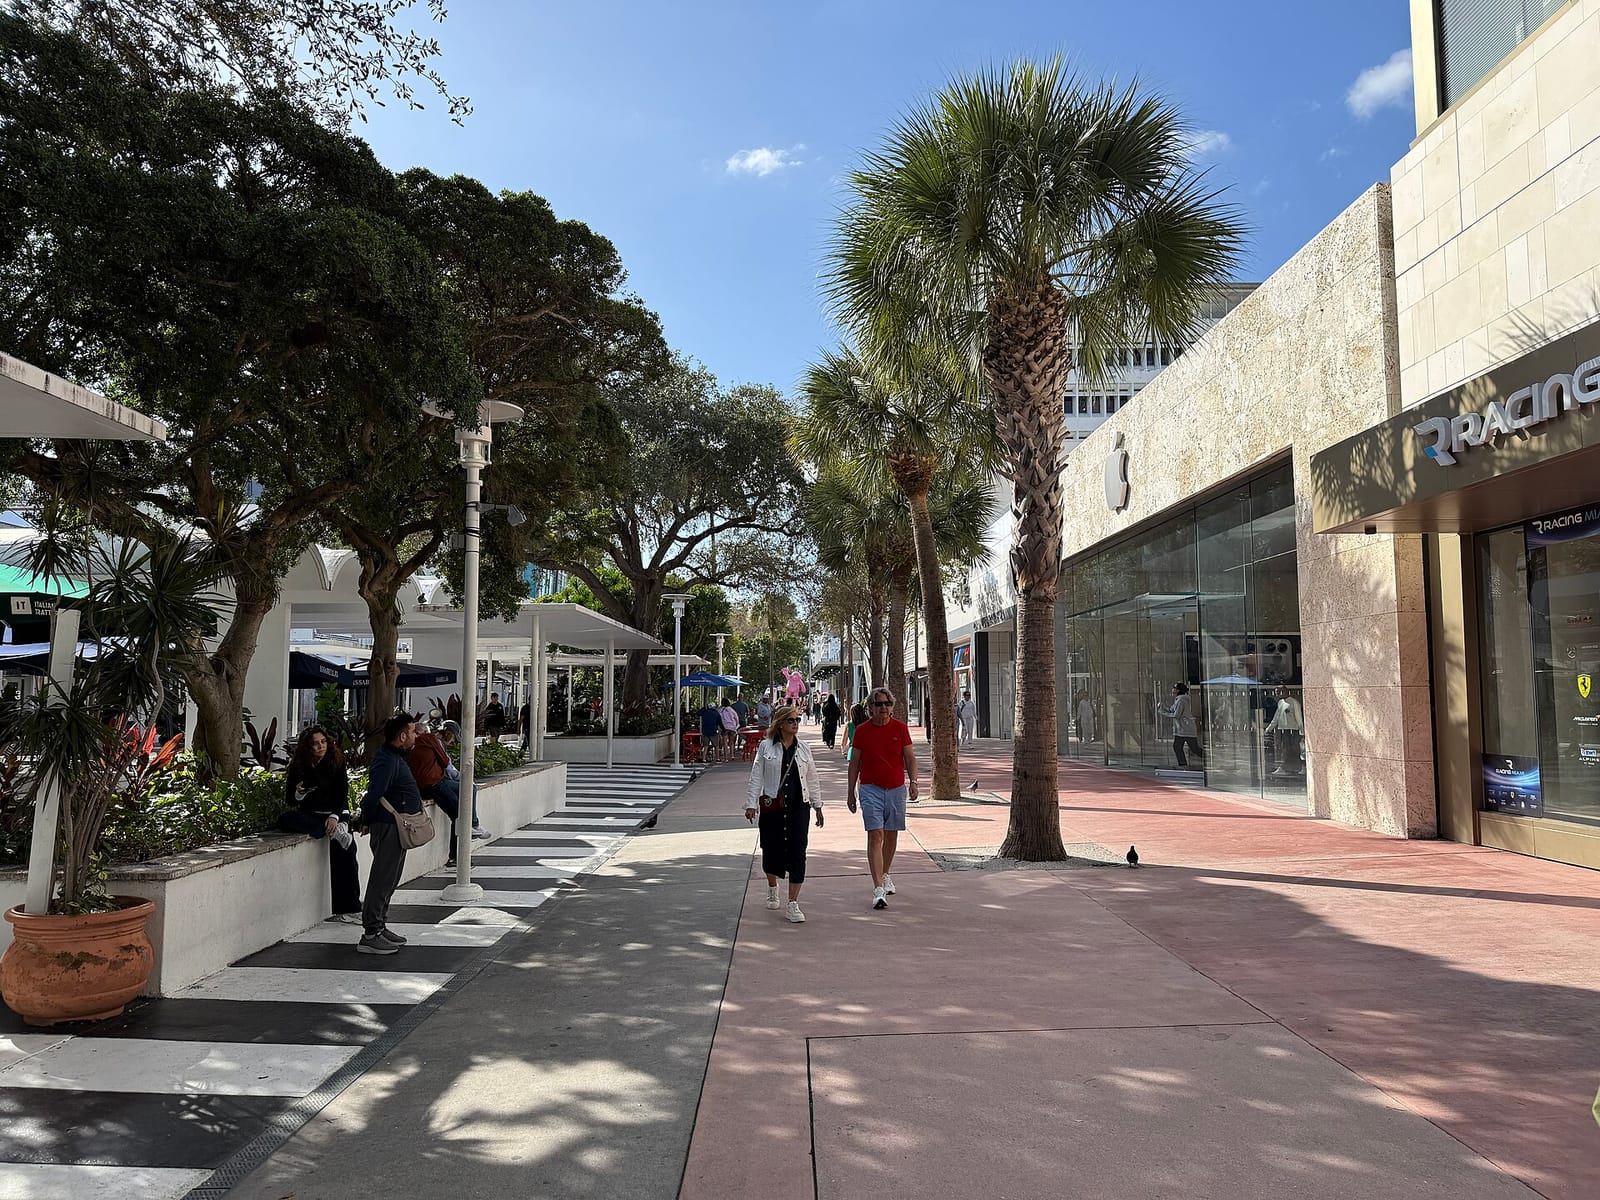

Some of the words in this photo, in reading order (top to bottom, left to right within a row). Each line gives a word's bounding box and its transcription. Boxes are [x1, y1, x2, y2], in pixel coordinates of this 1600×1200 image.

[1451, 356, 1600, 453] RACING
[1543, 512, 1583, 531] RACING
[16, 601, 26, 610] IT
